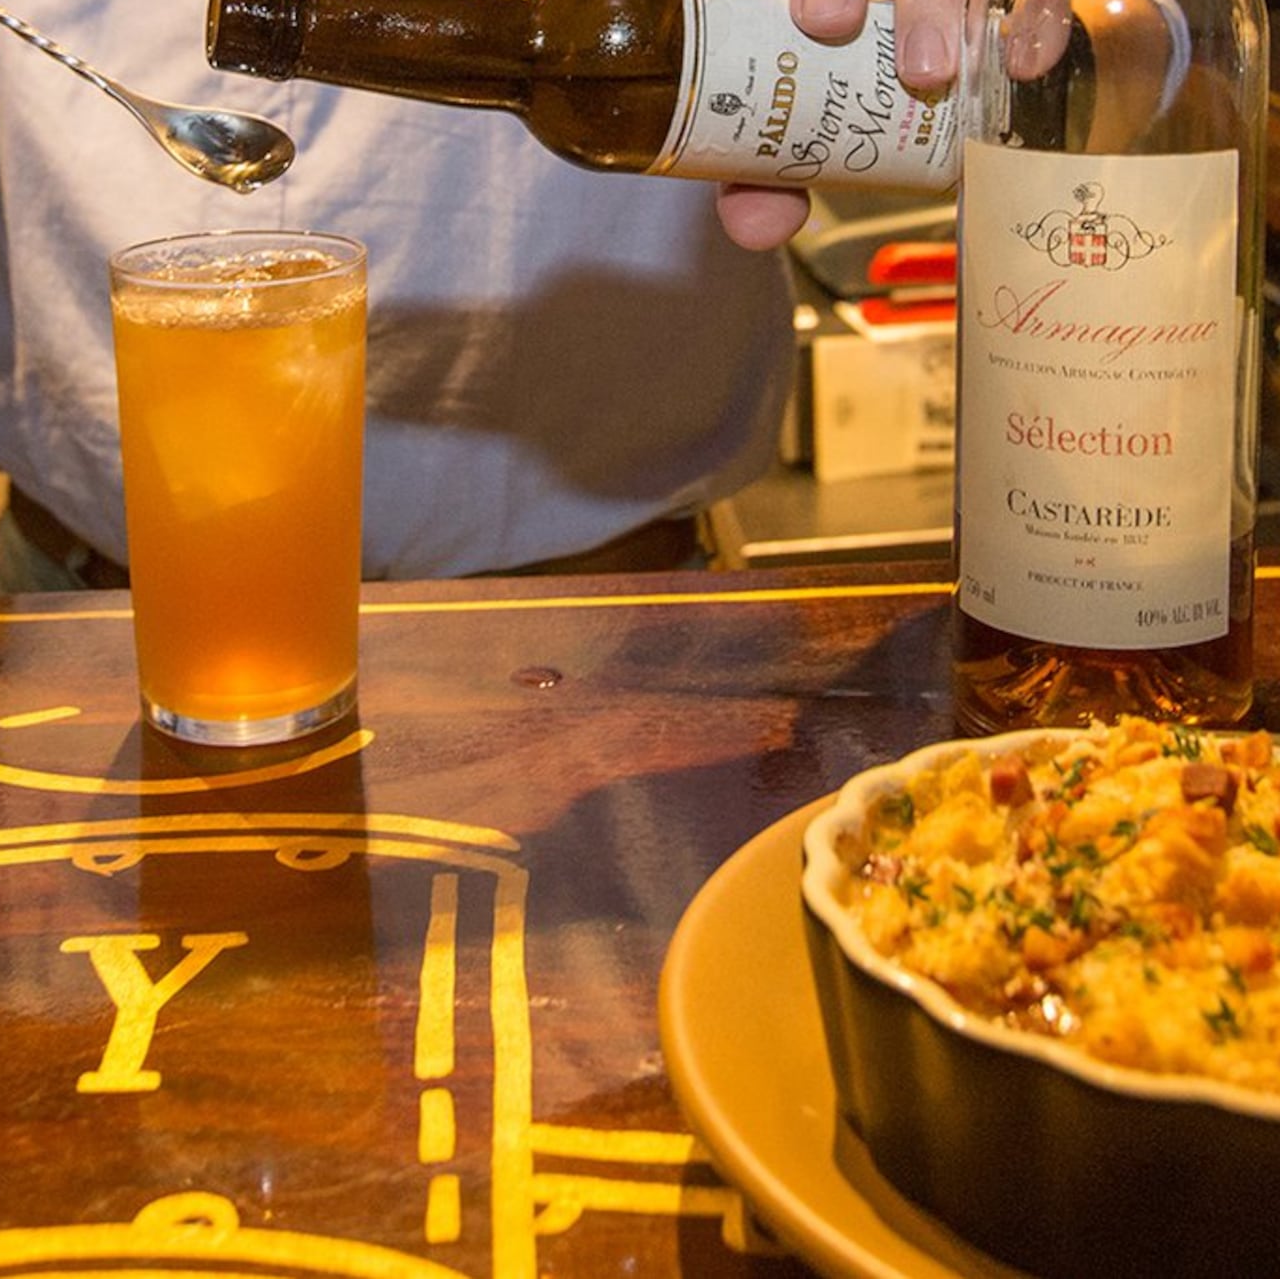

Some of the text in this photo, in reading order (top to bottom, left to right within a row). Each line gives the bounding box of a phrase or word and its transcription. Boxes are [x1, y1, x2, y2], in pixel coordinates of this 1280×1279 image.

[756, 51, 800, 159] PÁLIDO
[776, 72, 850, 182] Sierra
[976, 279, 1218, 363] Armagnac
[1006, 412, 1174, 458] Sélection
[1135, 609, 1168, 627] 40%
